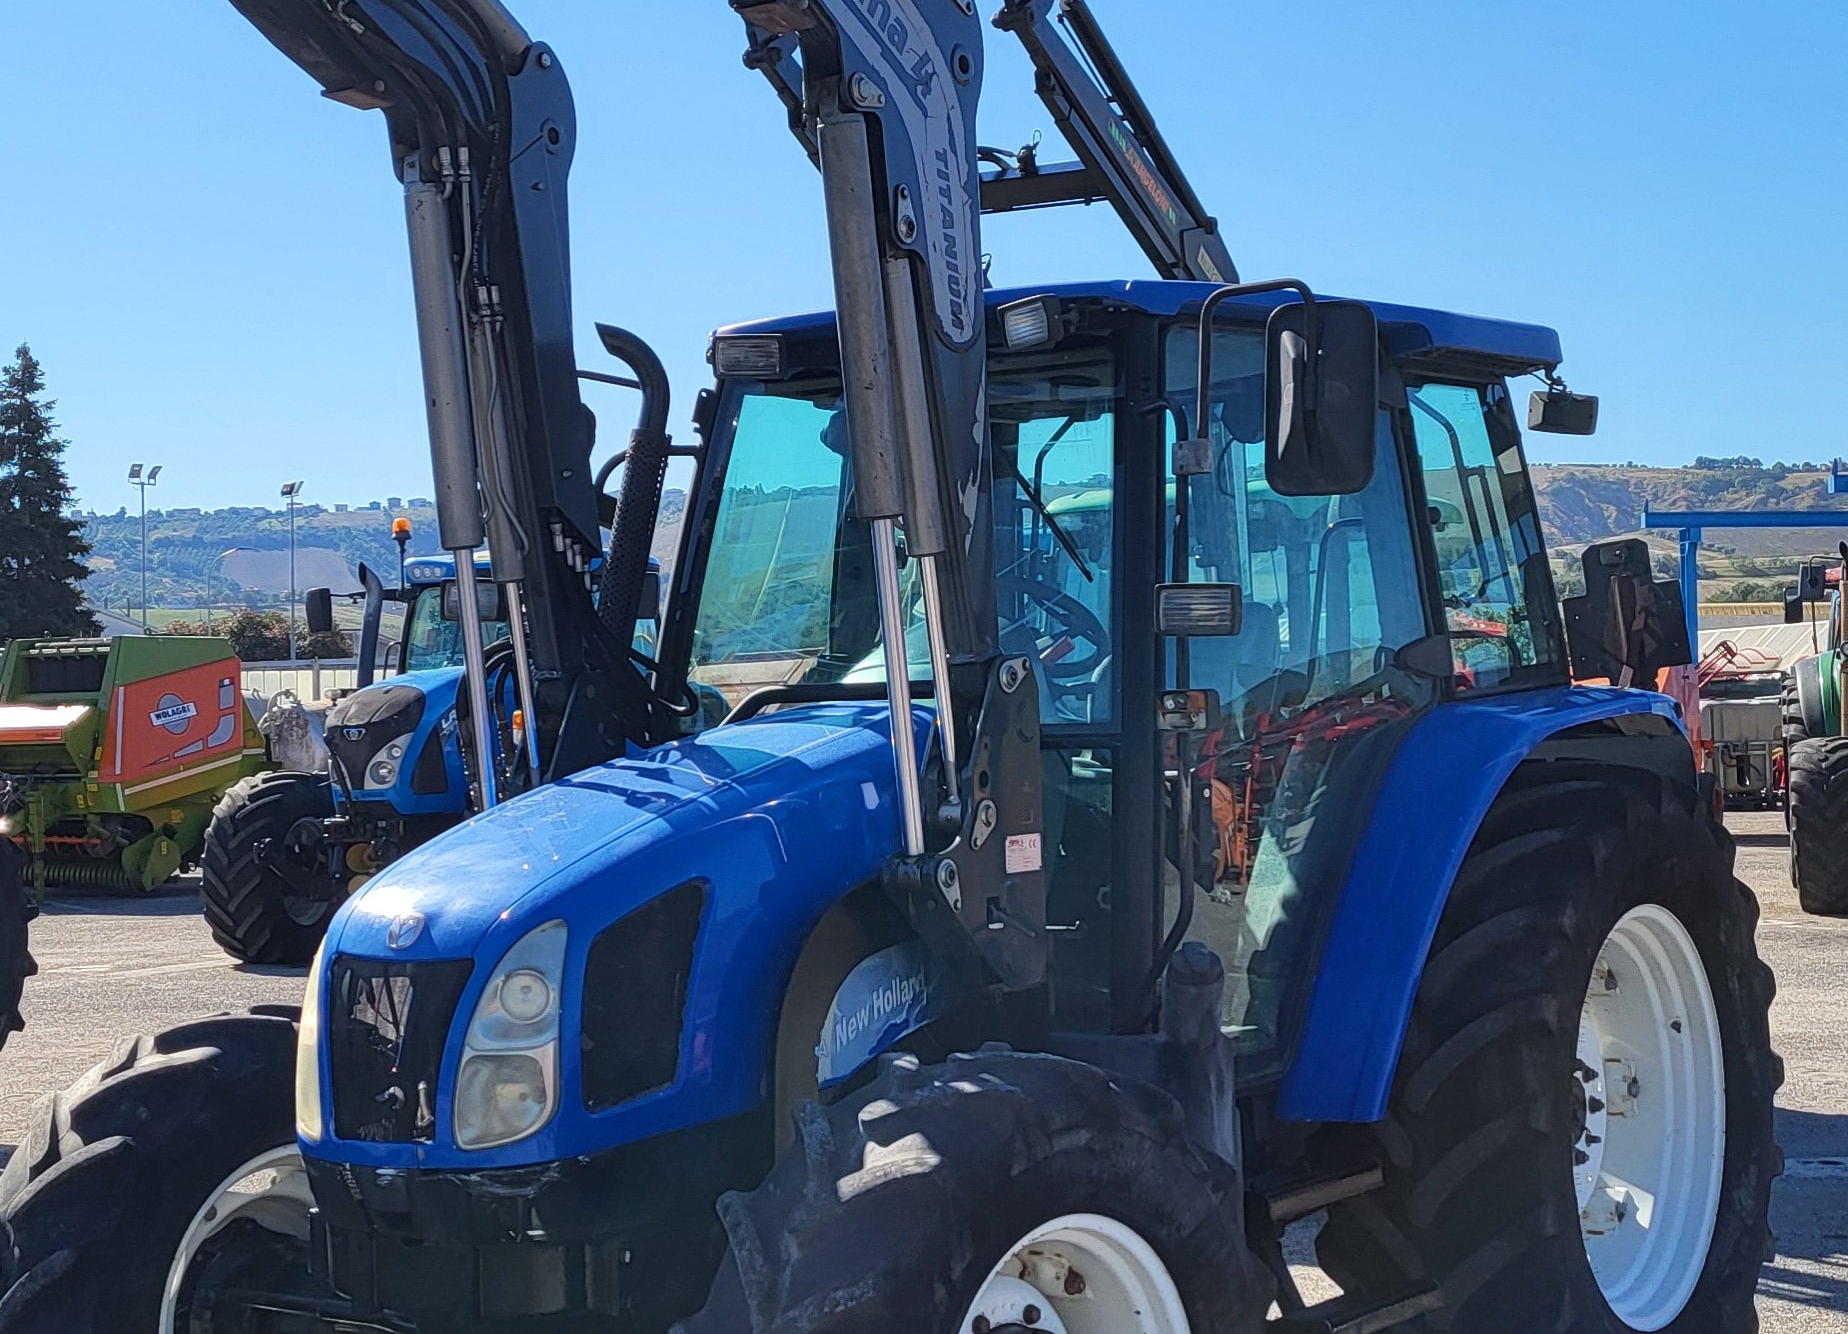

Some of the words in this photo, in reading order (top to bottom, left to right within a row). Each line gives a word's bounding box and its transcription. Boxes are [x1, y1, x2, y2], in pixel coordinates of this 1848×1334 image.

[934, 147, 965, 332] TITANIUM
[154, 705, 191, 721] WOLAGRI
[834, 1003, 871, 1054] New
[872, 964, 926, 1021] Holland
